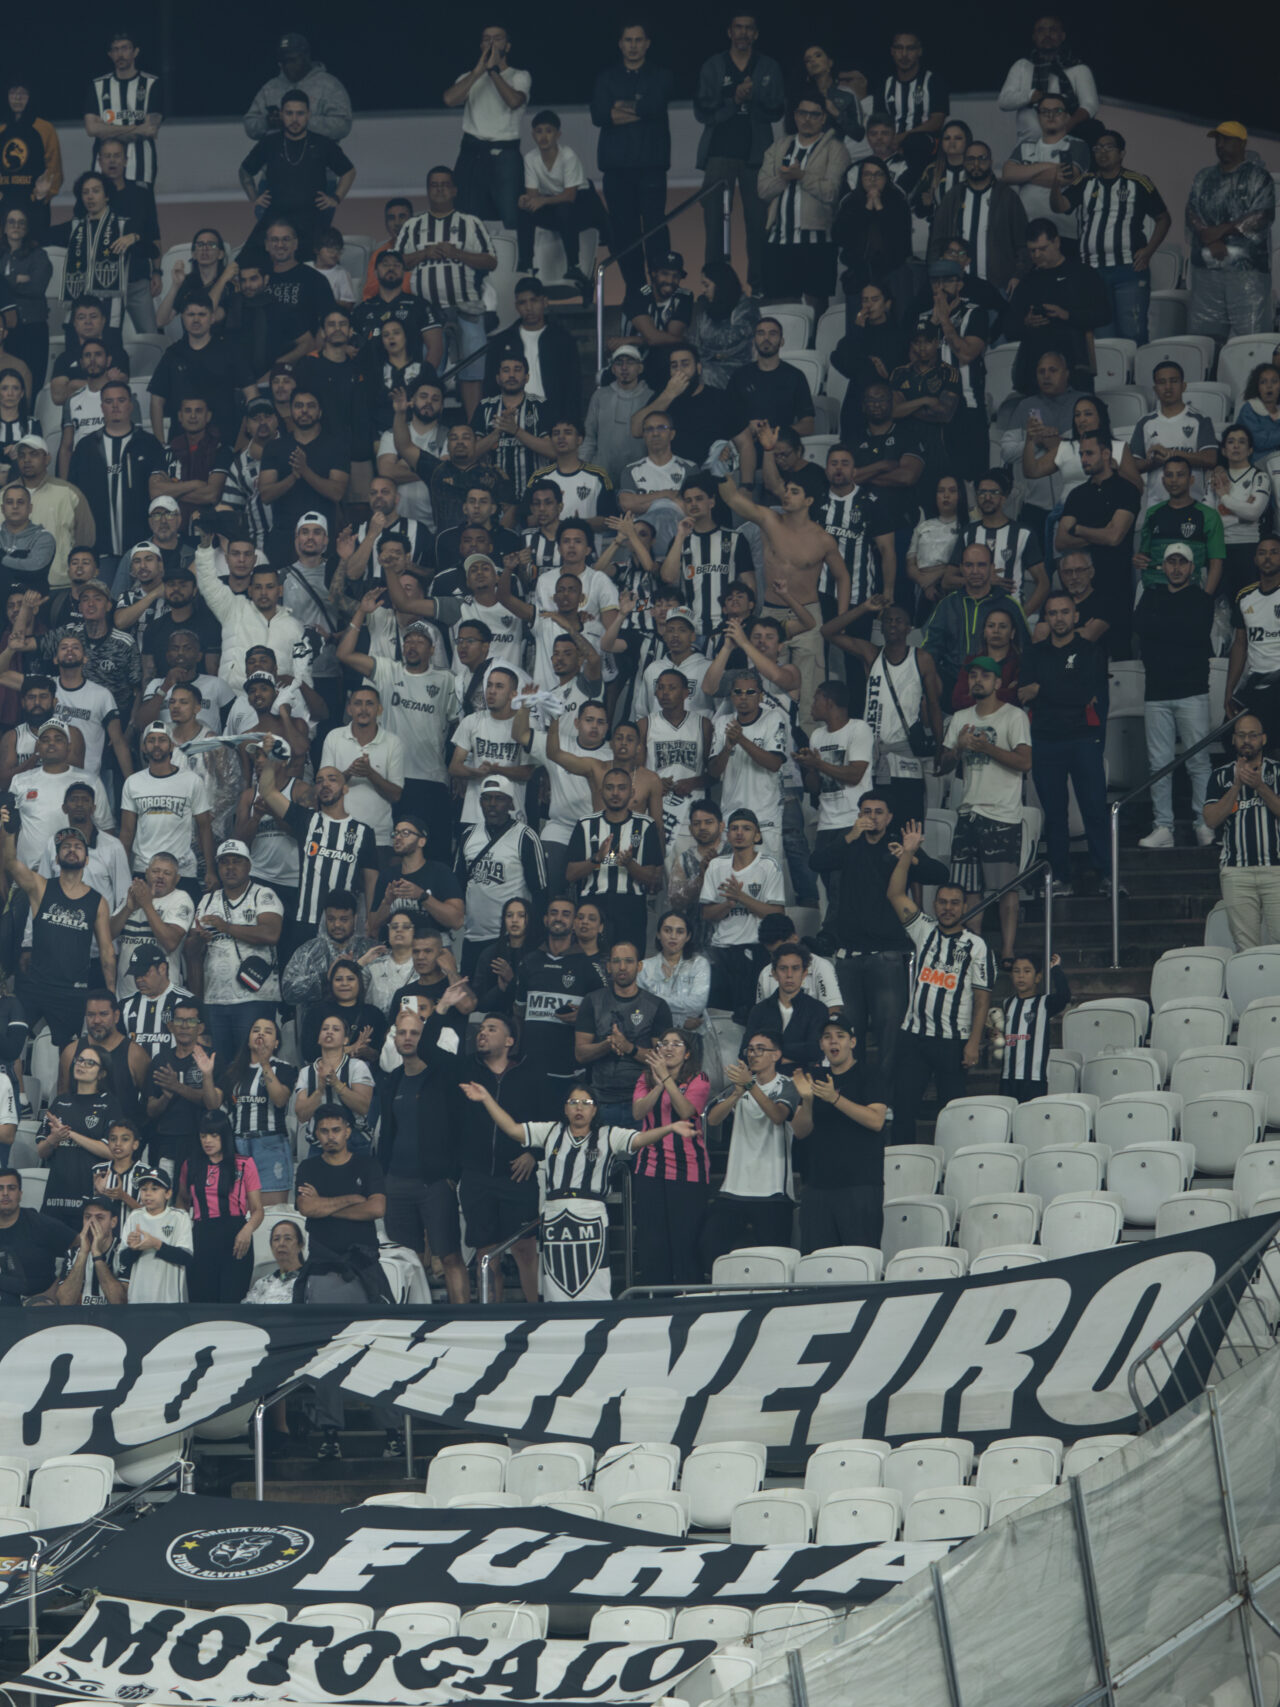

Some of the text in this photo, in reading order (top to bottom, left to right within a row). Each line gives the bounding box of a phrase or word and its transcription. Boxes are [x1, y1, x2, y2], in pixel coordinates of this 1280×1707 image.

[695, 563, 729, 575] BETANO
[1248, 627, 1264, 642] H2
[401, 698, 435, 714] BETANO
[318, 846, 356, 863] BETANO
[41, 911, 89, 930] FURIA
[119, 936, 157, 945] OTOGALO
[919, 966, 957, 990] BMG
[529, 994, 572, 1010] MRV
[135, 1032, 171, 1043] BETANO
[46, 1198, 64, 1208] AUTO
[546, 1225, 594, 1241] CAM
[303, 1250, 1217, 1448] MINEIRO
[192, 1526, 249, 1541] TORCIDA
[199, 1558, 291, 1579] ALVINEGRA
[60, 1600, 719, 1700] MOTOGALO
